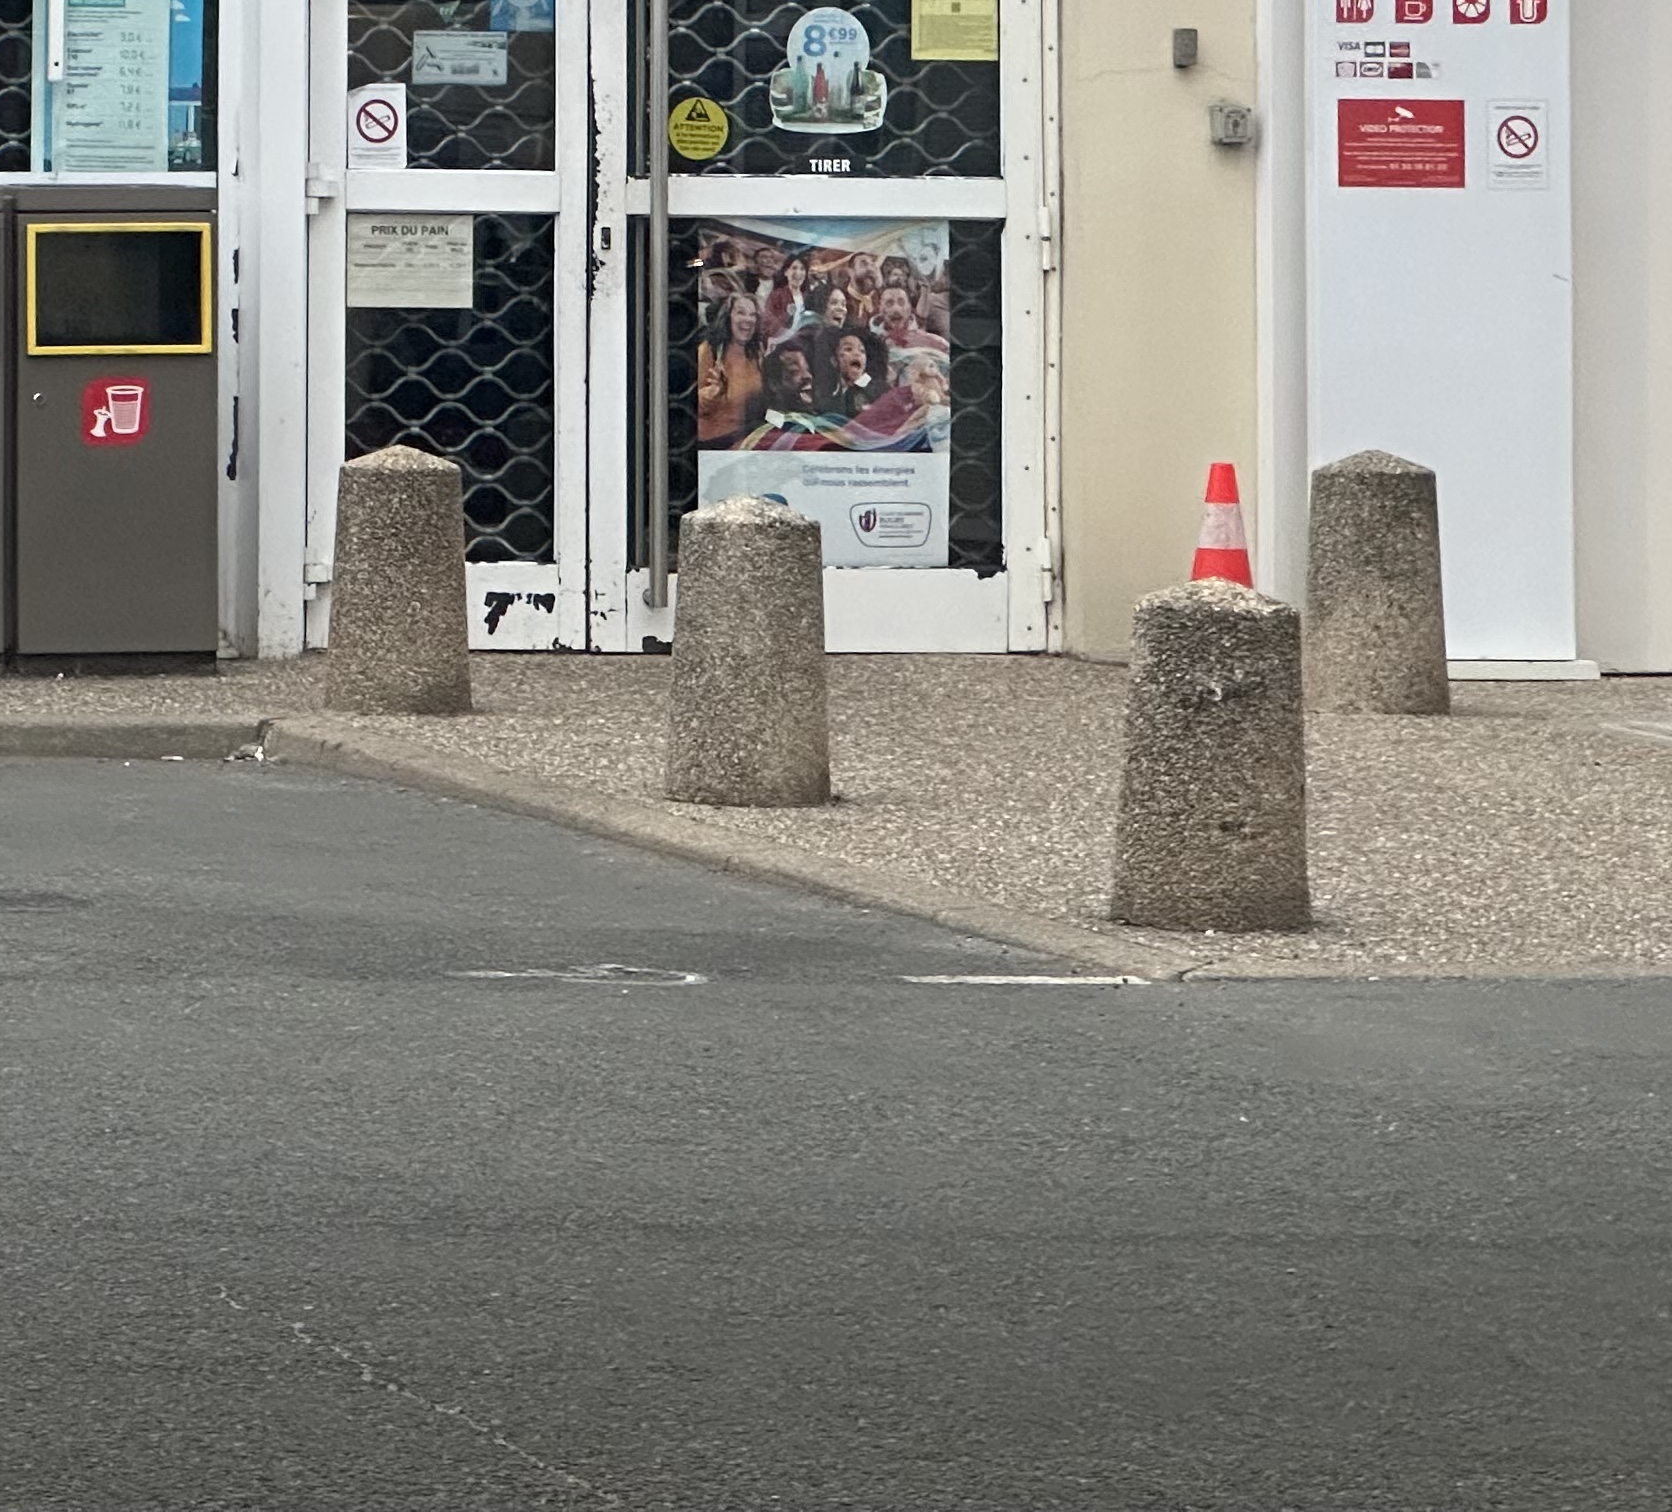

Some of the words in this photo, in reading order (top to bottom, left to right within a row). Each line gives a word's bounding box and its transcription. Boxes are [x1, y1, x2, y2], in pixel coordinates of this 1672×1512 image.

[1338, 41, 1361, 51] VISA
[673, 123, 724, 133] ATTENTION
[809, 158, 852, 173] TIRER
[371, 225, 399, 236] PRIX
[401, 225, 418, 236] DU
[421, 225, 449, 236] PAIN
